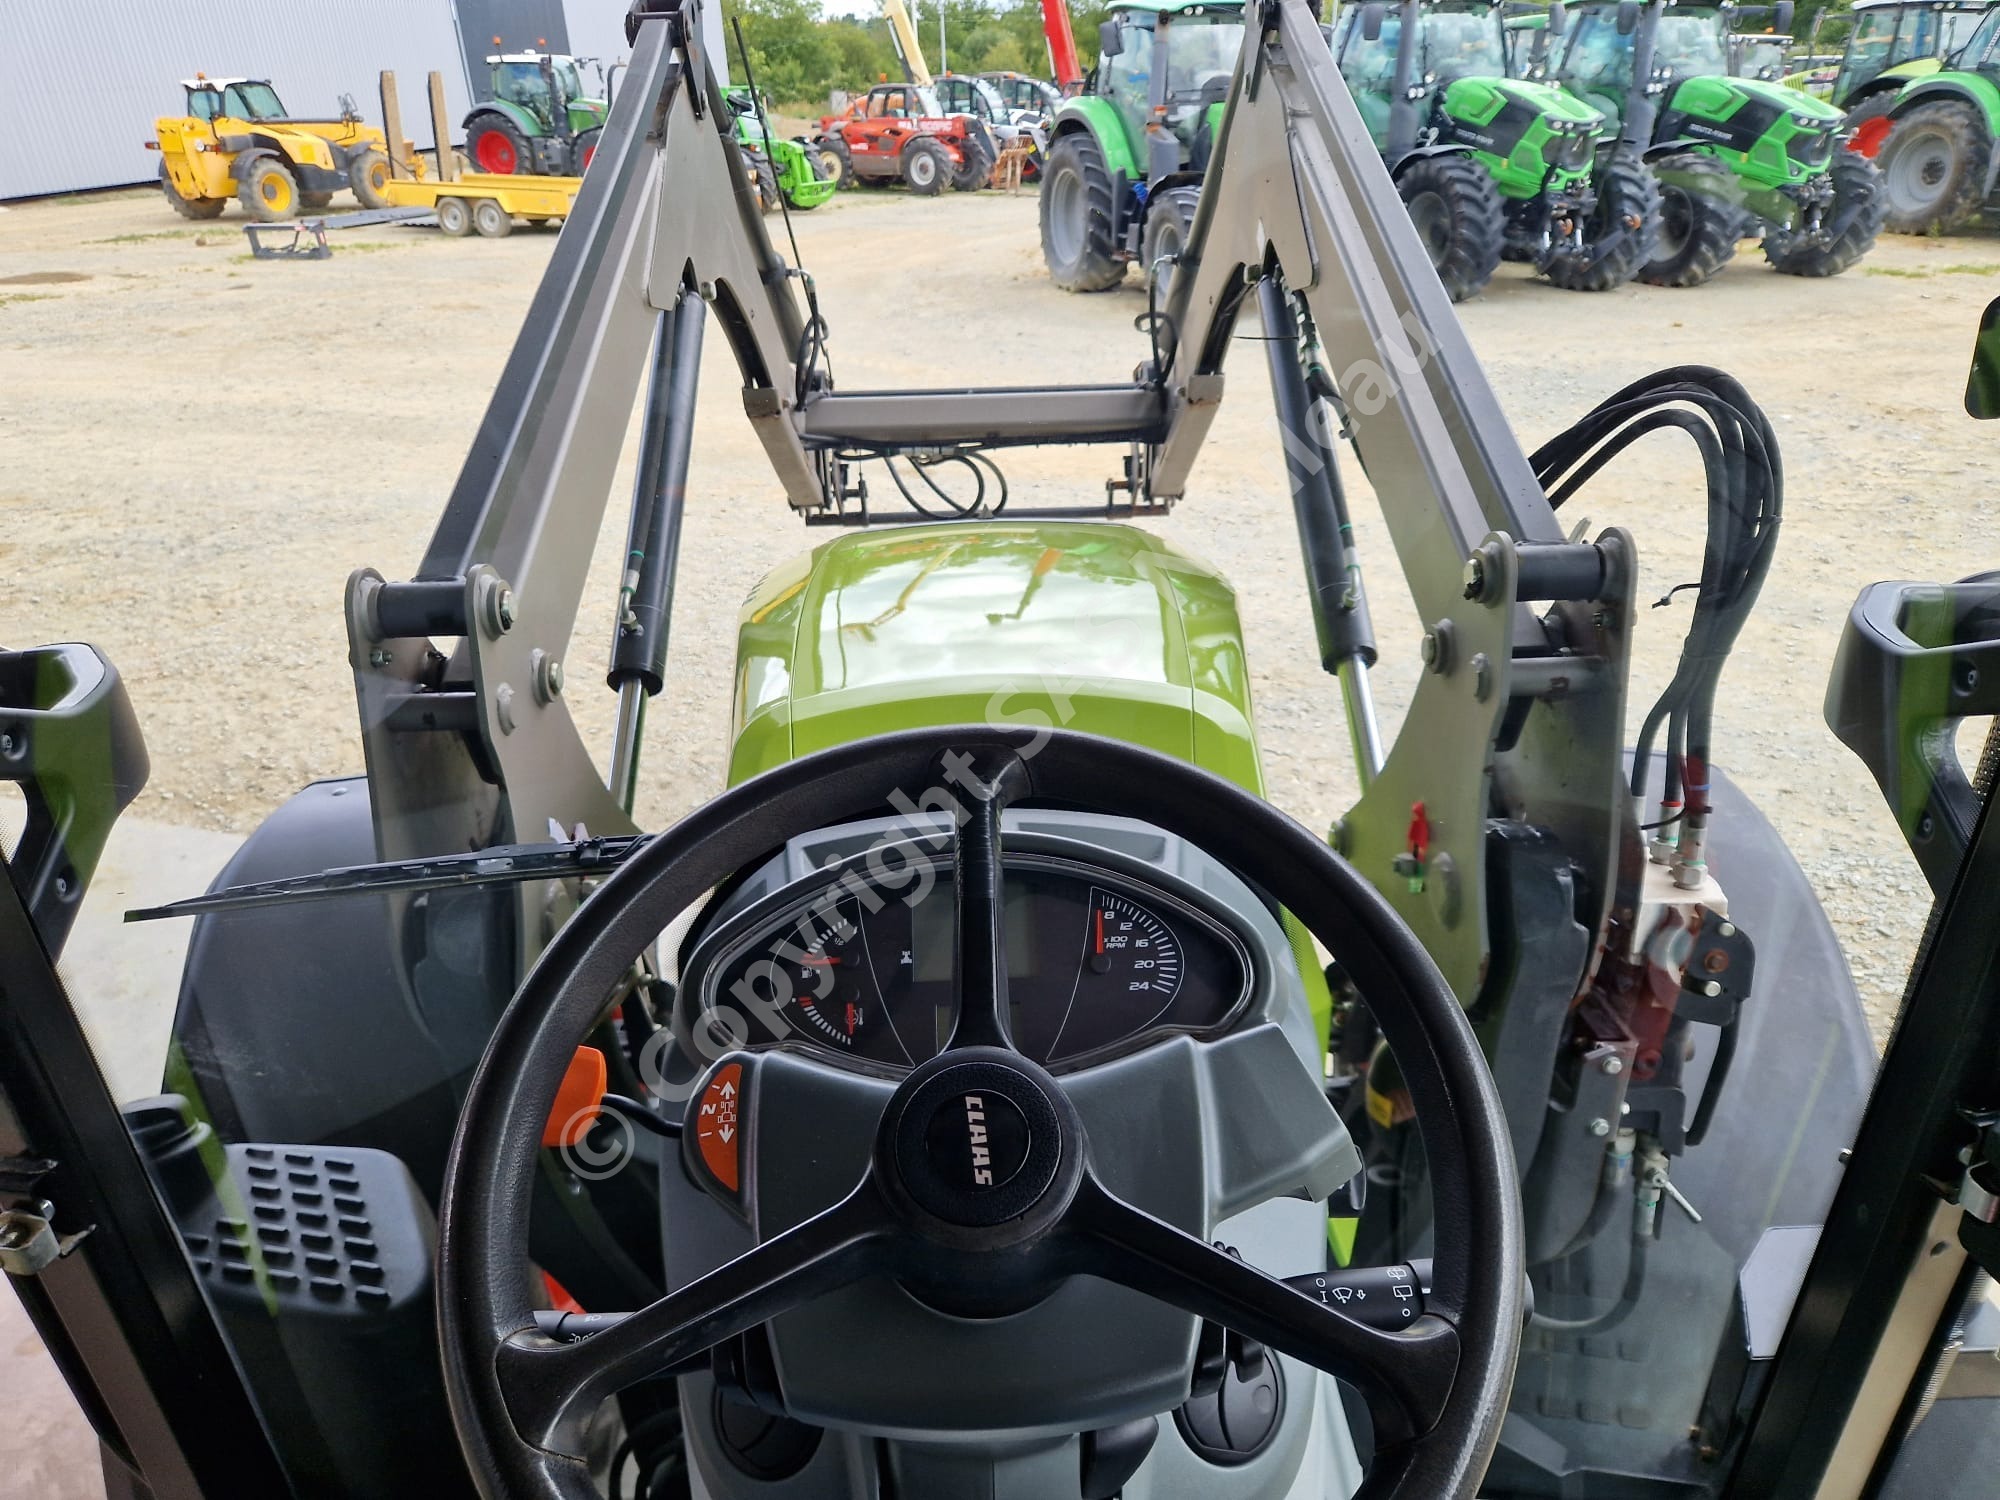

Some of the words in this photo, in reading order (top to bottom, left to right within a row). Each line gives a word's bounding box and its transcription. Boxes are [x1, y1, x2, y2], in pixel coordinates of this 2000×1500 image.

[1104, 911, 1115, 920] 8
[1120, 922, 1133, 931] 12
[1135, 939, 1149, 948] 16
[1134, 960, 1155, 969] 20
[1129, 981, 1150, 991] 24
[965, 1096, 992, 1186] CLAAS
